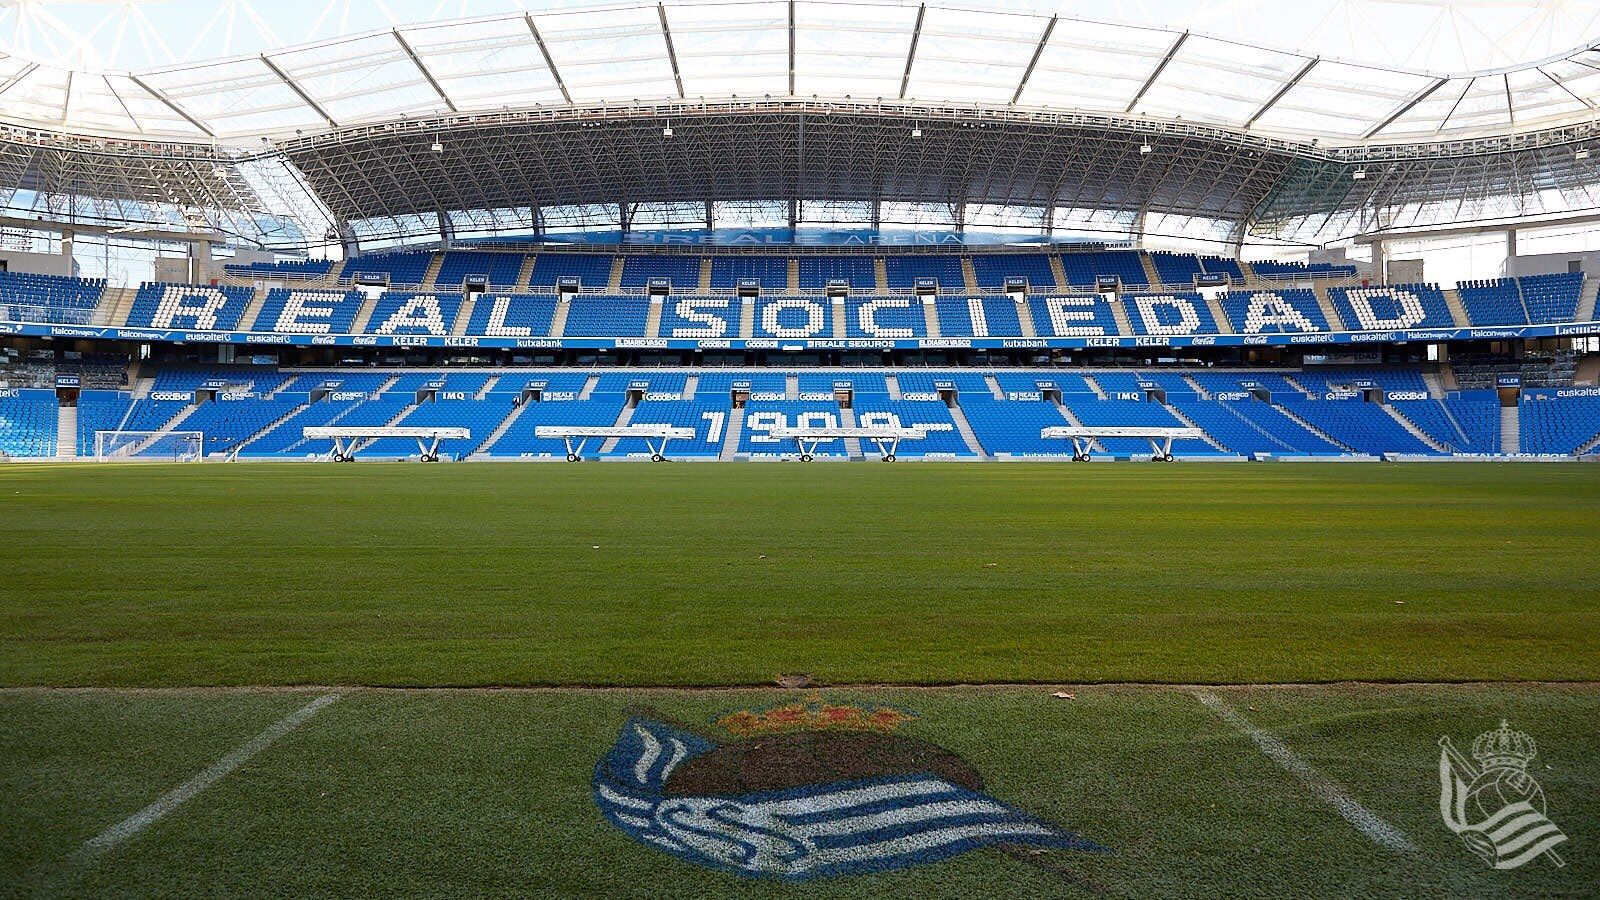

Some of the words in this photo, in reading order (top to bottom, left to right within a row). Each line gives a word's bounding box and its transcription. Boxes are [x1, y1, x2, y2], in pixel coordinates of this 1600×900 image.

[662, 234, 822, 245] REALE
[844, 234, 963, 245] ARENA
[151, 286, 530, 336] REAL
[673, 287, 1424, 338] SOCIEDAD
[185, 333, 224, 342] euskaltel
[246, 334, 284, 344] euskaltel
[392, 338, 427, 346] KELER
[444, 338, 478, 346] KELER
[1135, 337, 1170, 346] KELER
[1291, 334, 1328, 343] euskaltel
[1351, 333, 1389, 342] euskaltel
[516, 339, 563, 348] kutxabank
[814, 340, 846, 348] REALE
[848, 340, 896, 348] SEGUROS
[1003, 339, 1048, 348] kutxabank
[1086, 338, 1120, 347] KELER
[442, 392, 465, 401] IMQ
[1117, 393, 1140, 401] IMQ
[1557, 388, 1600, 399] euskaltel
